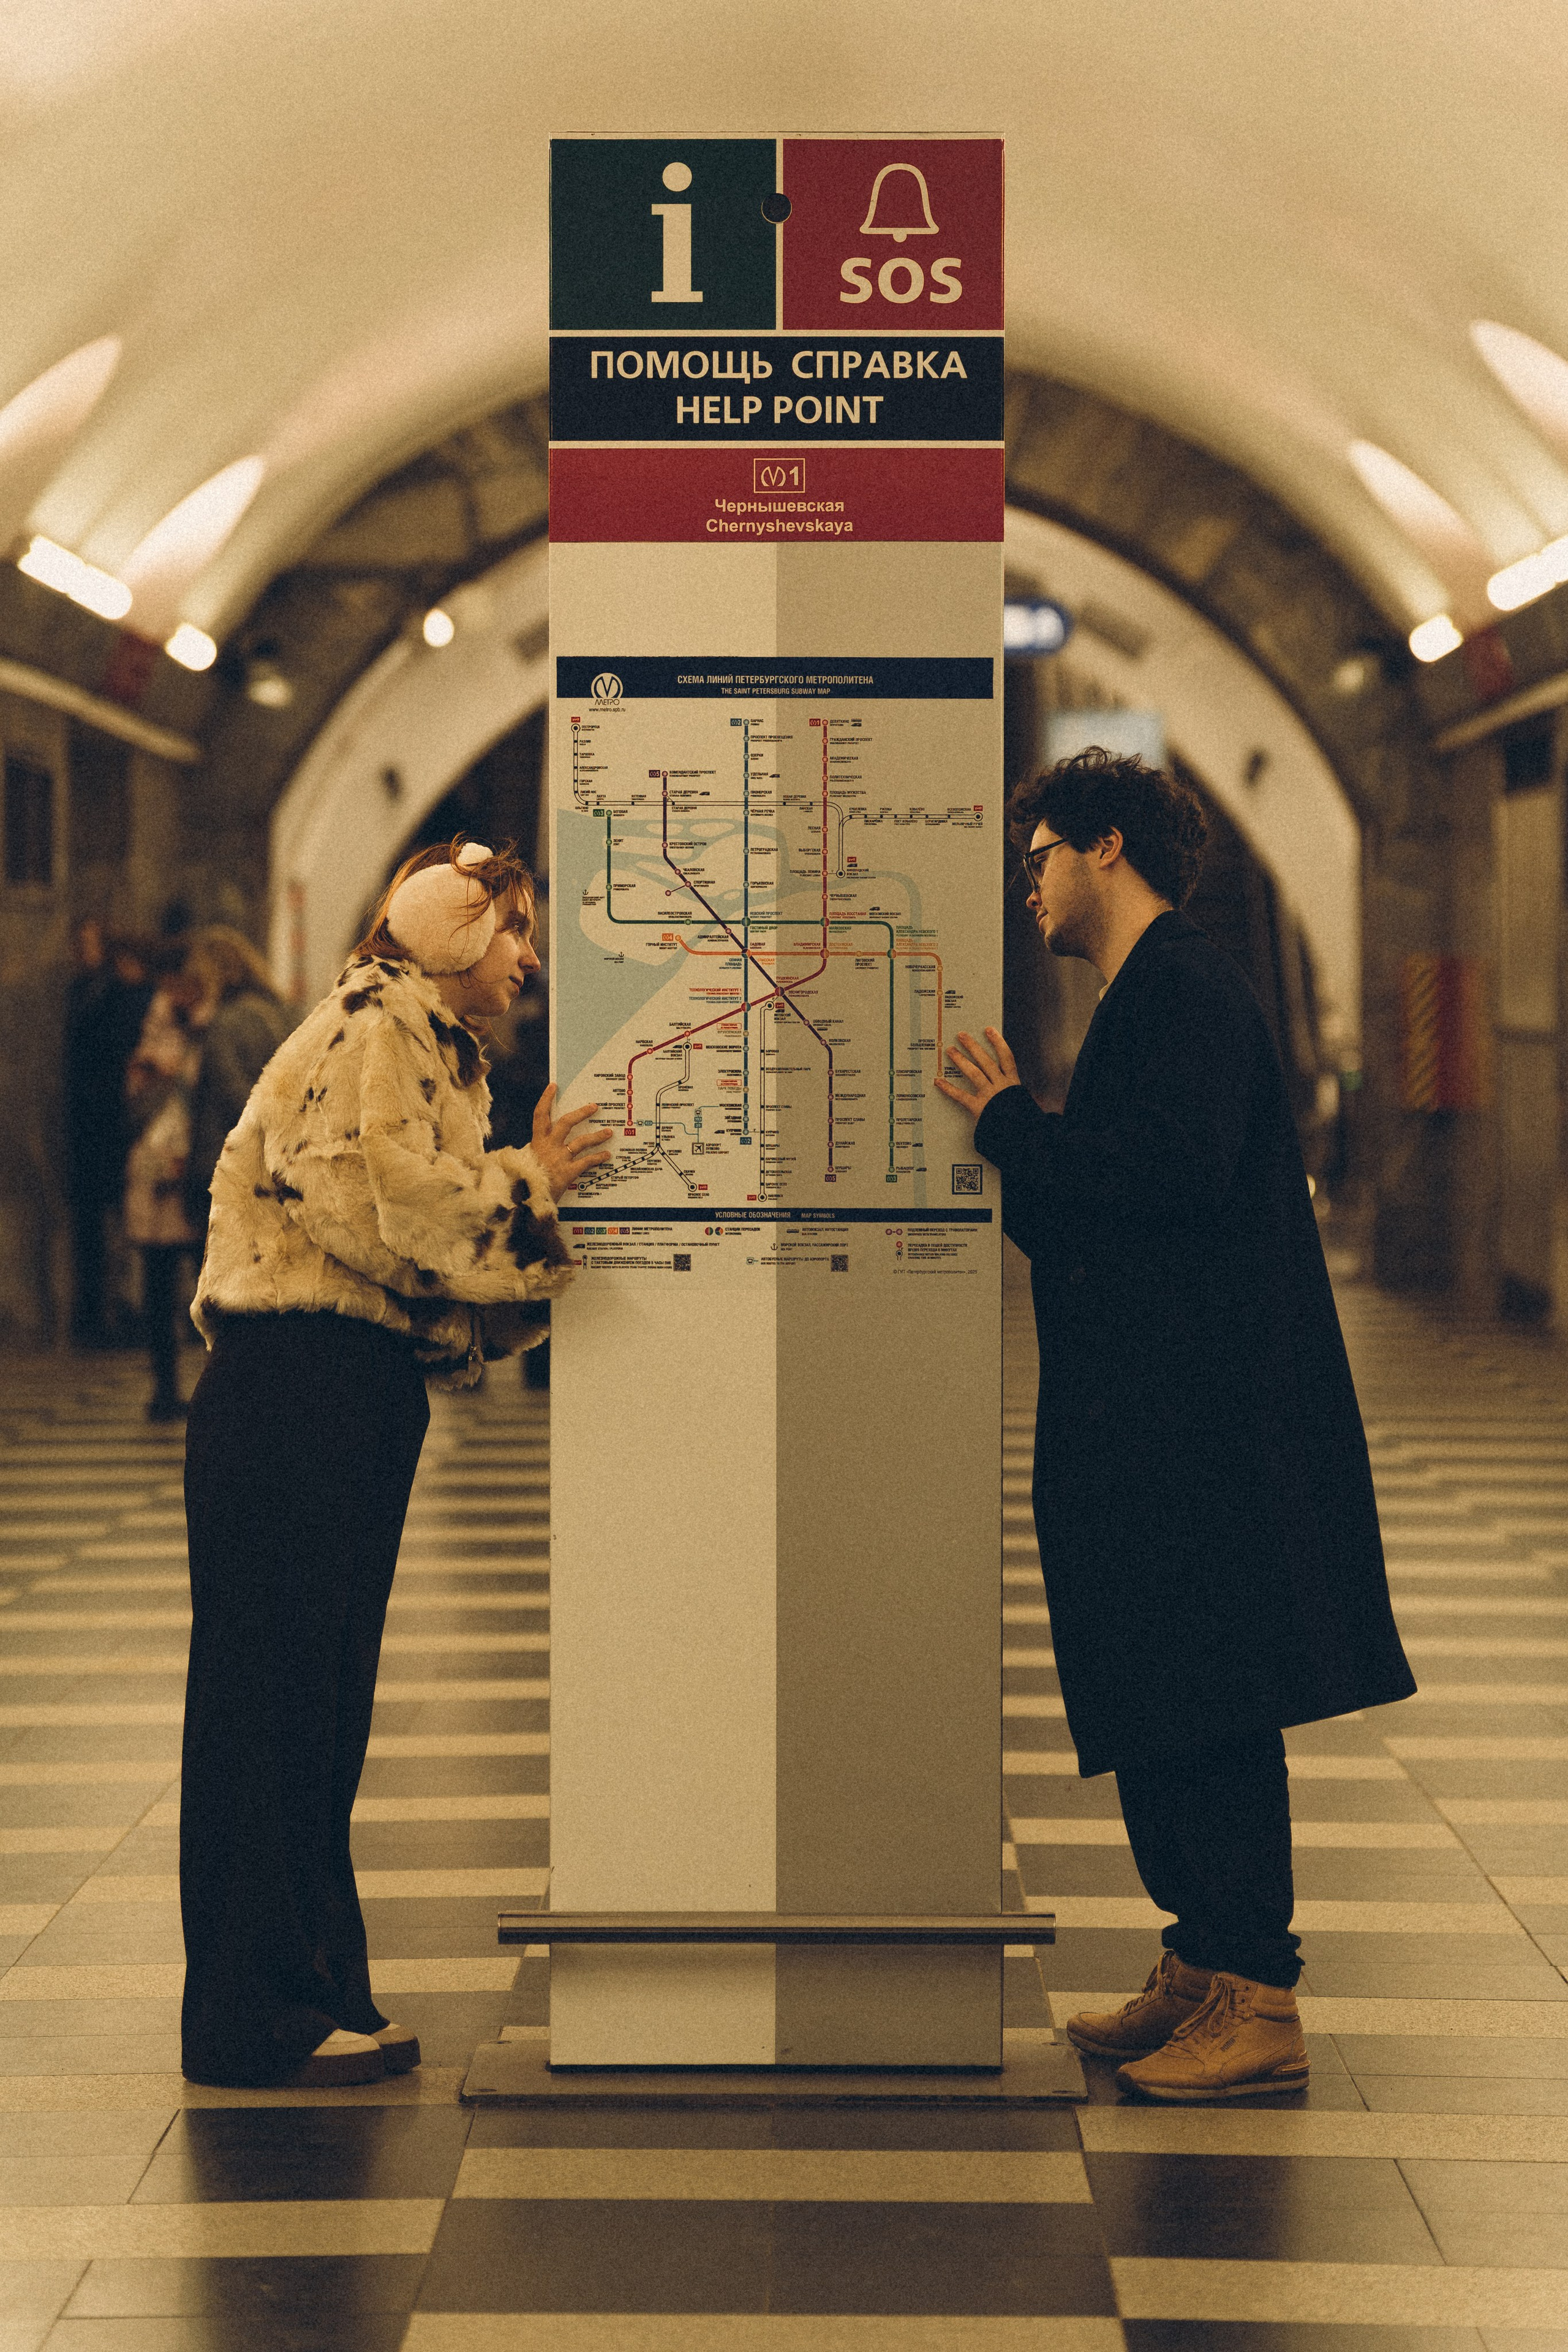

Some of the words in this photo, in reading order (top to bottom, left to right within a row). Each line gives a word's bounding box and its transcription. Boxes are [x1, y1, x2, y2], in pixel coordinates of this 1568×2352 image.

[839, 257, 963, 304] SOS
[590, 350, 773, 385] ПОМОЩЬ
[791, 350, 968, 379] СПРАВКА
[676, 396, 762, 424] HELP
[774, 396, 884, 424] POINT
[715, 499, 845, 516] Чернышевская
[706, 519, 854, 536] Chernyshevskaya
[677, 674, 704, 684] СХЕМА
[706, 674, 733, 684] ЛИНИЙ
[735, 674, 804, 684] ПЕТЕРБУРГСКОГО
[806, 675, 873, 685] МЕТРОПОЛИТЕНА
